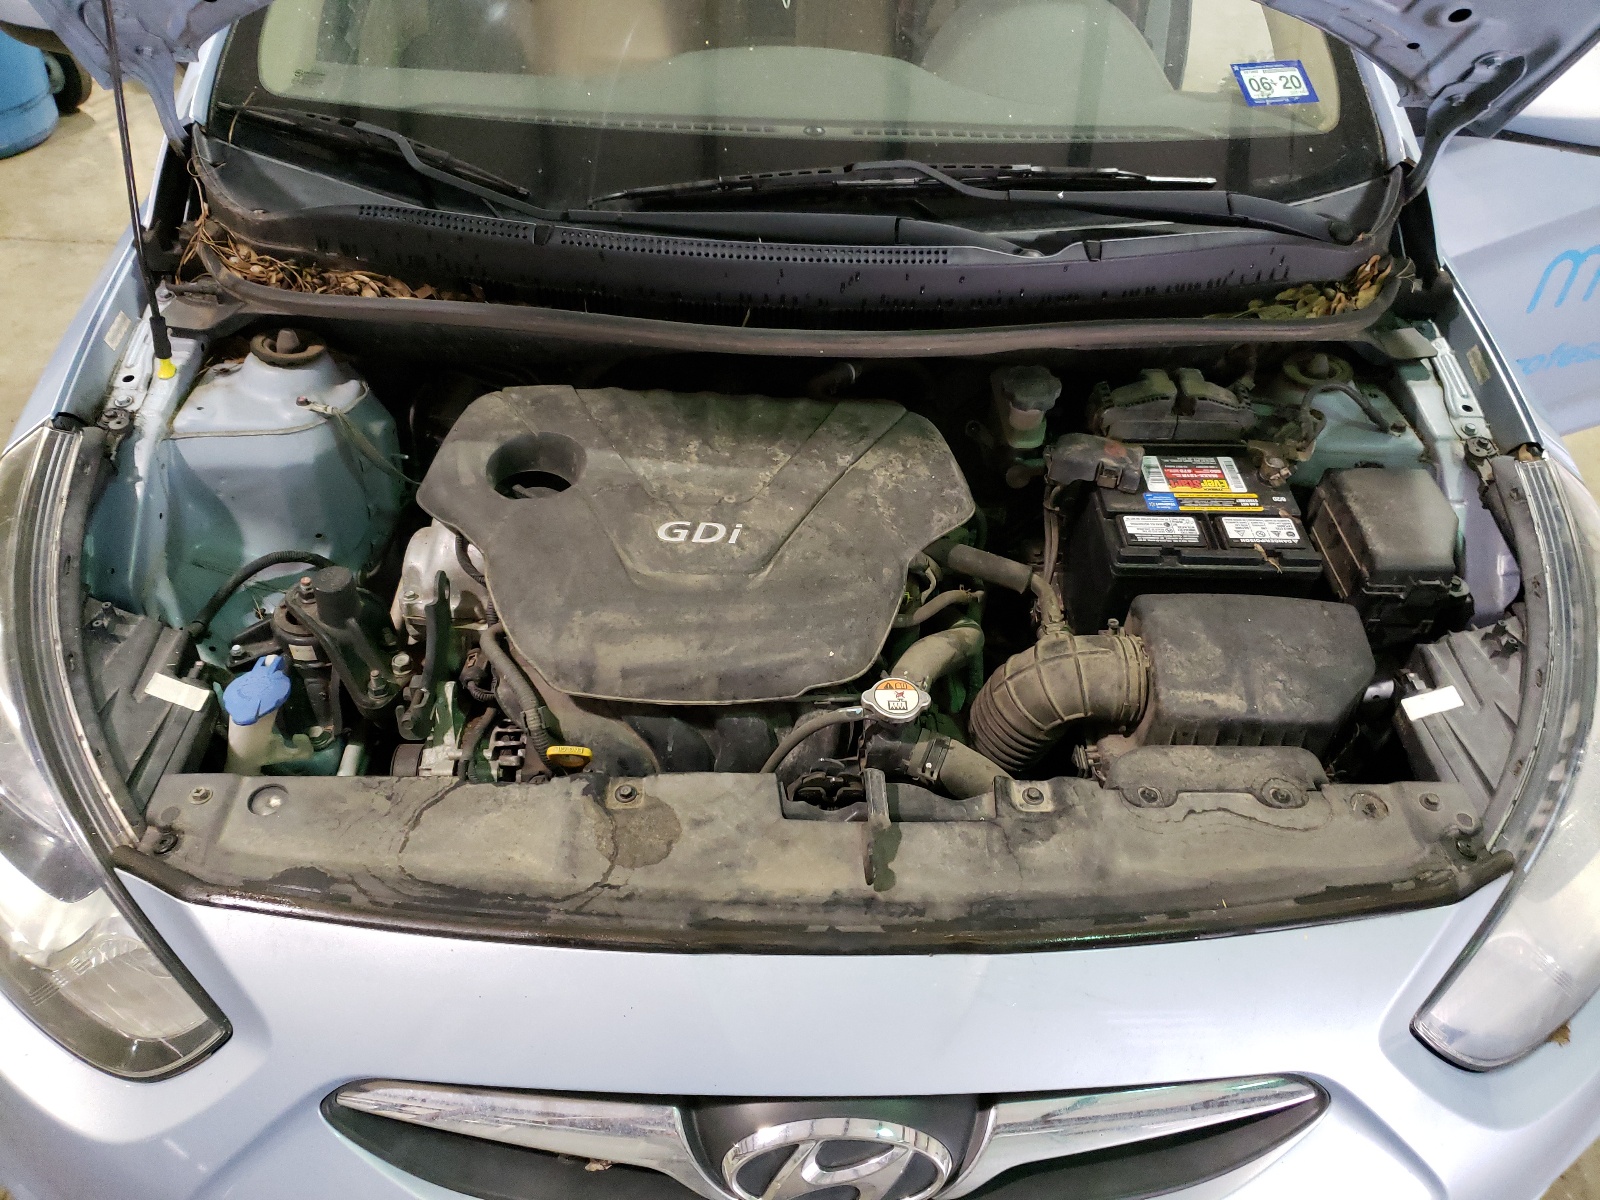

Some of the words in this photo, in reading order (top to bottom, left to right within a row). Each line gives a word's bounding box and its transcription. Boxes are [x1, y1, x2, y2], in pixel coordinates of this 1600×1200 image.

[1248, 76, 1272, 92] 06
[1278, 74, 1303, 90] 20
[657, 521, 743, 544] GDi
